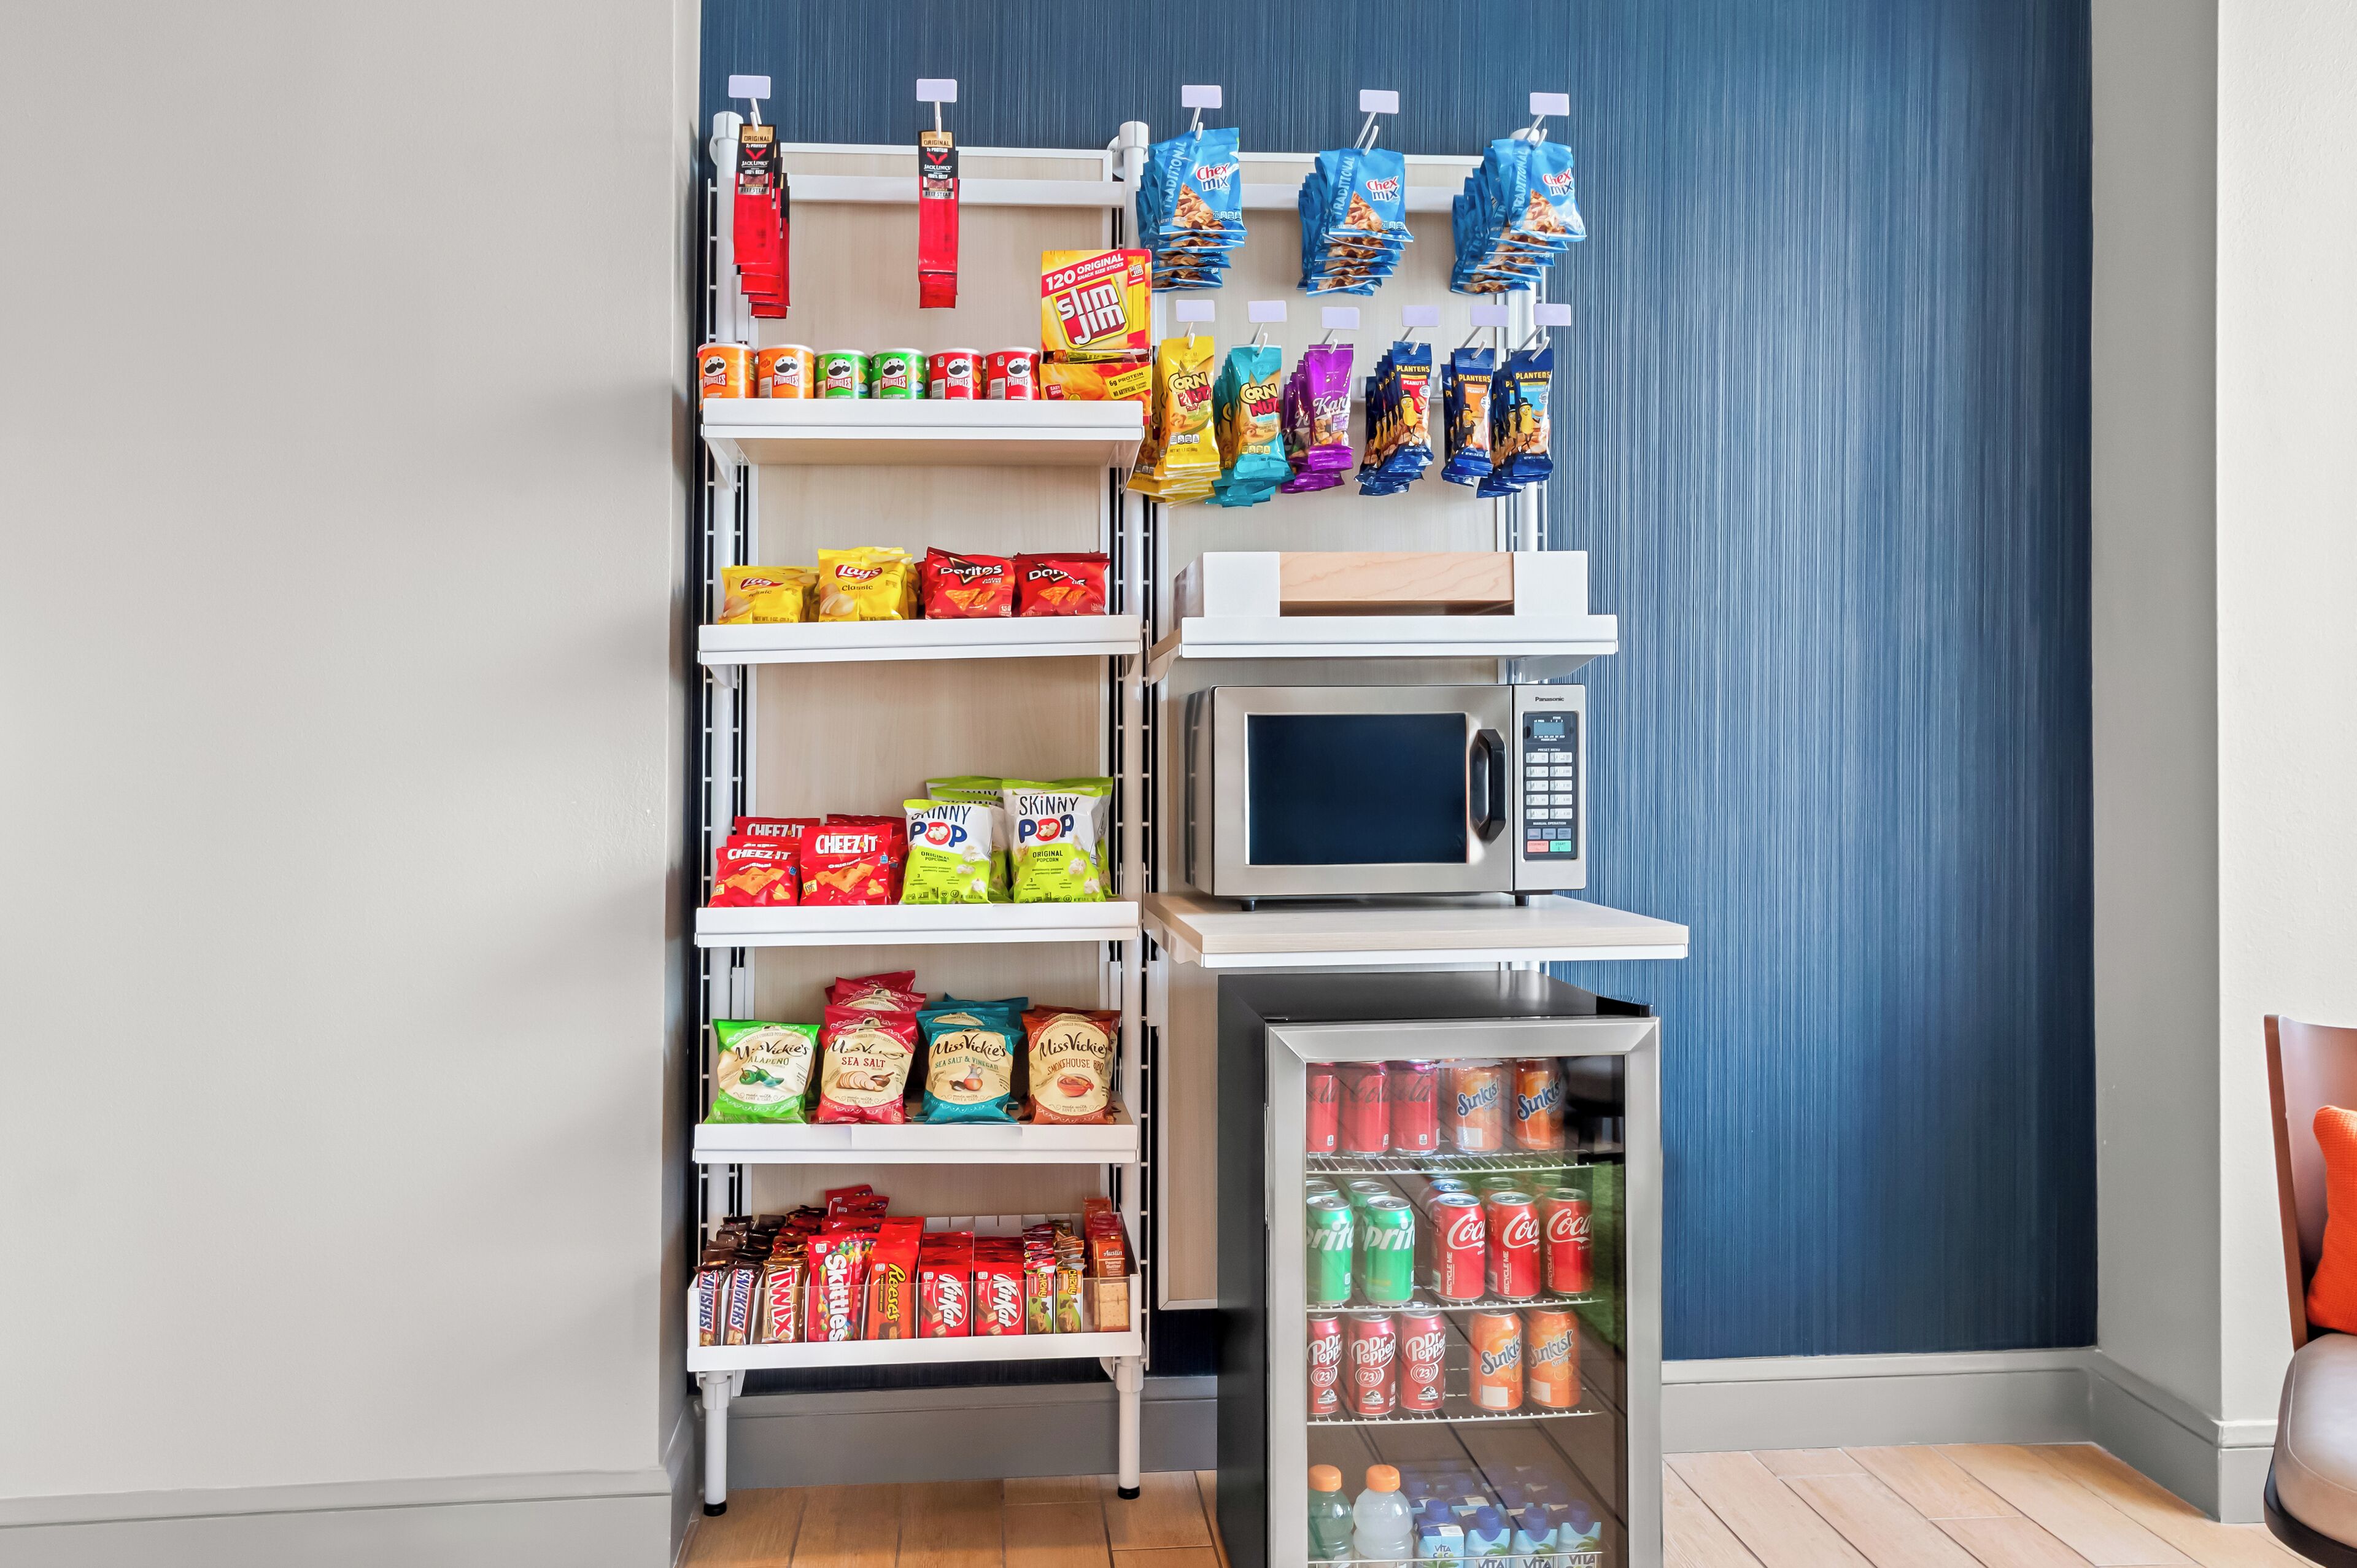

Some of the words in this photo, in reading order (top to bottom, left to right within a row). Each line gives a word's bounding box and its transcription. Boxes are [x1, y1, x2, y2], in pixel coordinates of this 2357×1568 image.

[1197, 164, 1228, 180] Chex
[1543, 169, 1571, 185] Chex
[1202, 176, 1228, 190] mix
[1333, 156, 1355, 215] TRADITIONAL
[1367, 177, 1398, 191] Chex
[1550, 181, 1573, 195] mix
[1374, 187, 1399, 201] mix
[1046, 269, 1076, 291] 120
[1077, 253, 1124, 274] ORIGINAL
[1077, 271, 1094, 280] SNACK
[1106, 262, 1124, 271] STICKS
[1056, 284, 1119, 322] slim
[1074, 304, 1126, 344] jim
[1396, 365, 1430, 373] PLANTERS
[1515, 371, 1550, 380] PLANTERS
[704, 375, 726, 387] PRINGLES
[774, 374, 799, 387] PRINGLES
[827, 377, 852, 390] PRINGLES
[882, 376, 907, 389] PRINGLES
[947, 377, 971, 388] PRINGLES
[1118, 371, 1144, 383] PROTEIN
[1168, 371, 1208, 393] CORN
[1458, 374, 1491, 383] PLANTERS
[1118, 386, 1136, 395] ARTIFICIAL
[1239, 383, 1278, 404] CORN
[838, 565, 880, 580] Lay's
[940, 565, 1002, 576] Doritos
[910, 821, 968, 848] POP
[1018, 814, 1074, 843] POP
[921, 852, 950, 860] ORIGINAL
[765, 1040, 808, 1057] Vickie's
[931, 1041, 964, 1059] Miss
[962, 1033, 1006, 1062] Vickie's
[1039, 1038, 1069, 1061] Miss
[842, 1057, 859, 1067] SEA
[863, 1058, 886, 1068] SALT
[935, 1060, 946, 1068] SEA
[948, 1057, 962, 1065] SALT
[972, 1057, 999, 1070] VINEGAR
[1047, 1058, 1091, 1075] SMOKEHOUSE
[1093, 1060, 1104, 1075] BBQ
[1457, 1076, 1501, 1116] Sunkist
[1547, 1208, 1592, 1243] Coca
[1447, 1251, 1452, 1263] ME
[1503, 1251, 1509, 1262] ME
[1547, 1244, 1552, 1256] ME
[731, 1269, 750, 1329] SNICKERS
[825, 1254, 850, 1341] Skittles
[888, 1263, 906, 1322] Reese's
[700, 1273, 715, 1330] SATISFIES
[770, 1269, 796, 1338] TWIX
[1326, 1334, 1341, 1352] Dr
[1369, 1337, 1387, 1352] Dr
[1424, 1332, 1441, 1348] Dr
[1351, 1338, 1395, 1366] Pepper
[1529, 1329, 1573, 1369] Sunkist
[1552, 1353, 1571, 1366] Orange
[1320, 1372, 1331, 1381] 23
[1363, 1372, 1374, 1382] 23
[1419, 1369, 1430, 1378] 23
[1478, 1558, 1504, 1568] VITA
[1523, 1556, 1552, 1568] VITA
[1569, 1553, 1596, 1565] VITA
